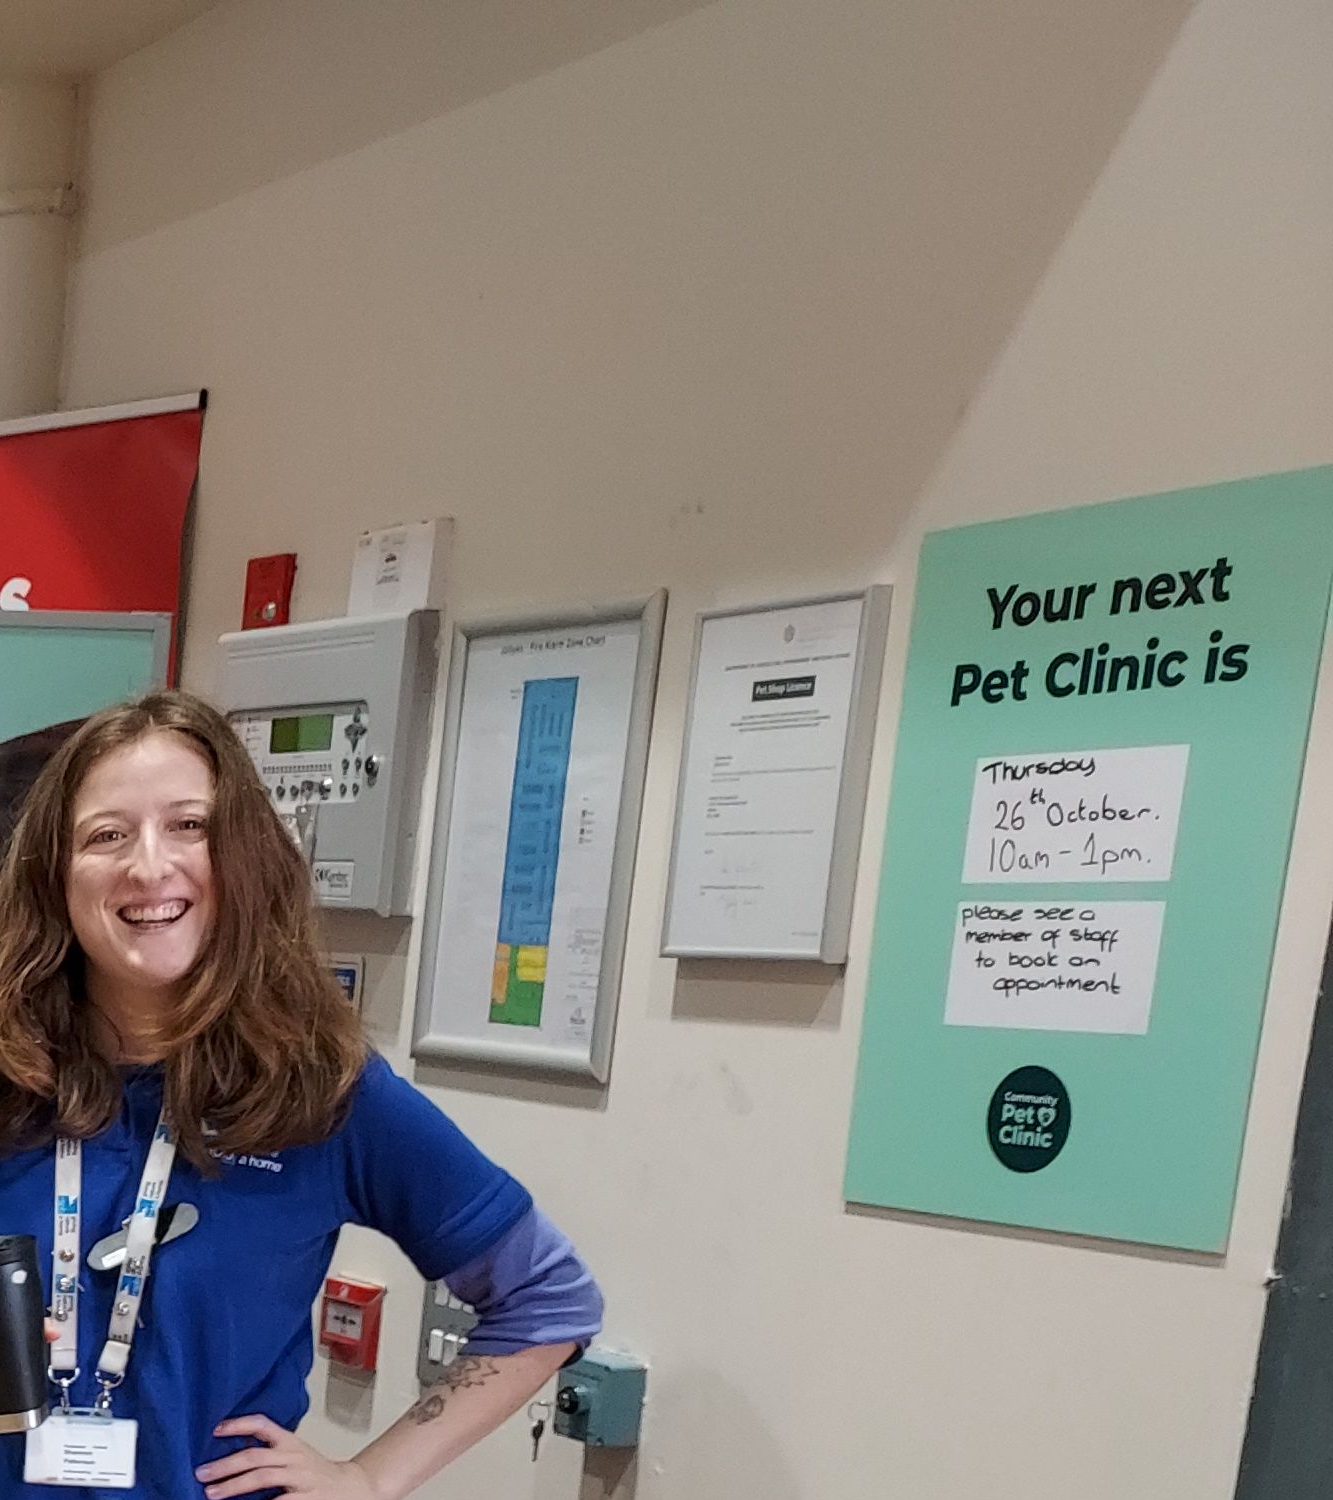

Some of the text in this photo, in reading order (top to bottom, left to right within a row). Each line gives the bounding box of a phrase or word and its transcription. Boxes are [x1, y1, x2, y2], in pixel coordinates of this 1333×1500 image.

[986, 557, 1233, 633] Your next
[950, 630, 1250, 707] Pet Clinic is
[982, 757, 1096, 785] Thursday
[989, 837, 1050, 873] 10am
[961, 906, 1095, 927] please see a
[965, 928, 1120, 952] member of staff
[976, 951, 1100, 968] to book an
[992, 972, 1121, 999] appointment
[1004, 1089, 1058, 1107] Community
[1001, 1102, 1035, 1126] Pet
[998, 1124, 1053, 1150] Clinic
